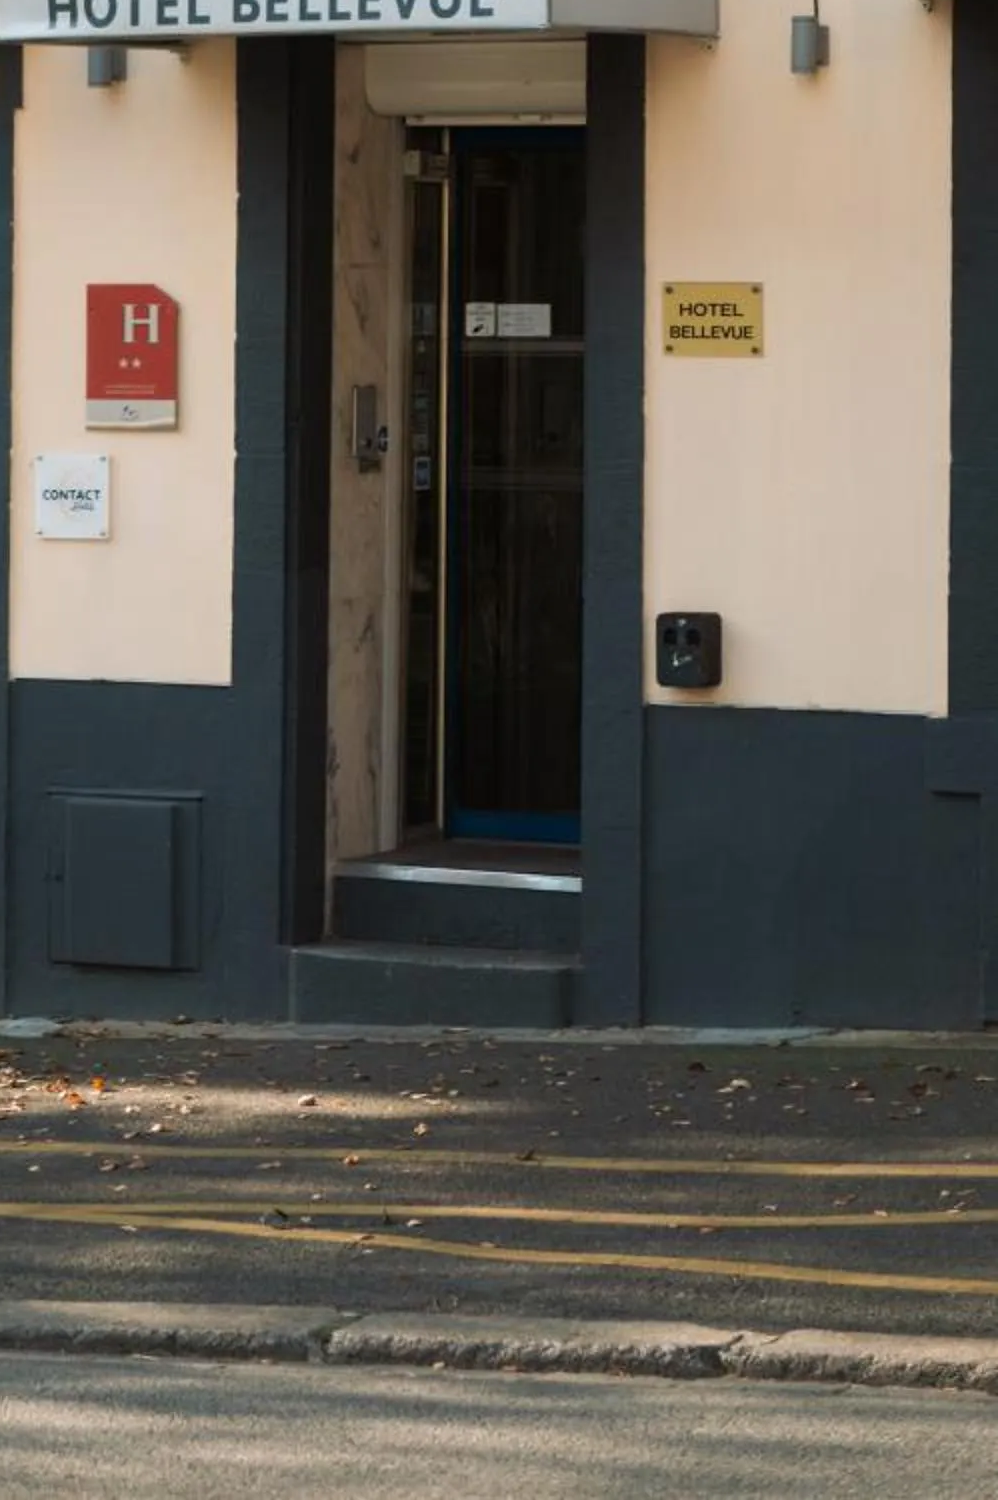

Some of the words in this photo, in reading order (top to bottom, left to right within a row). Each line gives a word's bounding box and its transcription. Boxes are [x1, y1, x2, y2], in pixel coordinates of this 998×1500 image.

[679, 303, 744, 317] HOTEL
[122, 303, 159, 343] H
[669, 325, 754, 339] BELLEVUE
[42, 489, 101, 501] CONTACT
